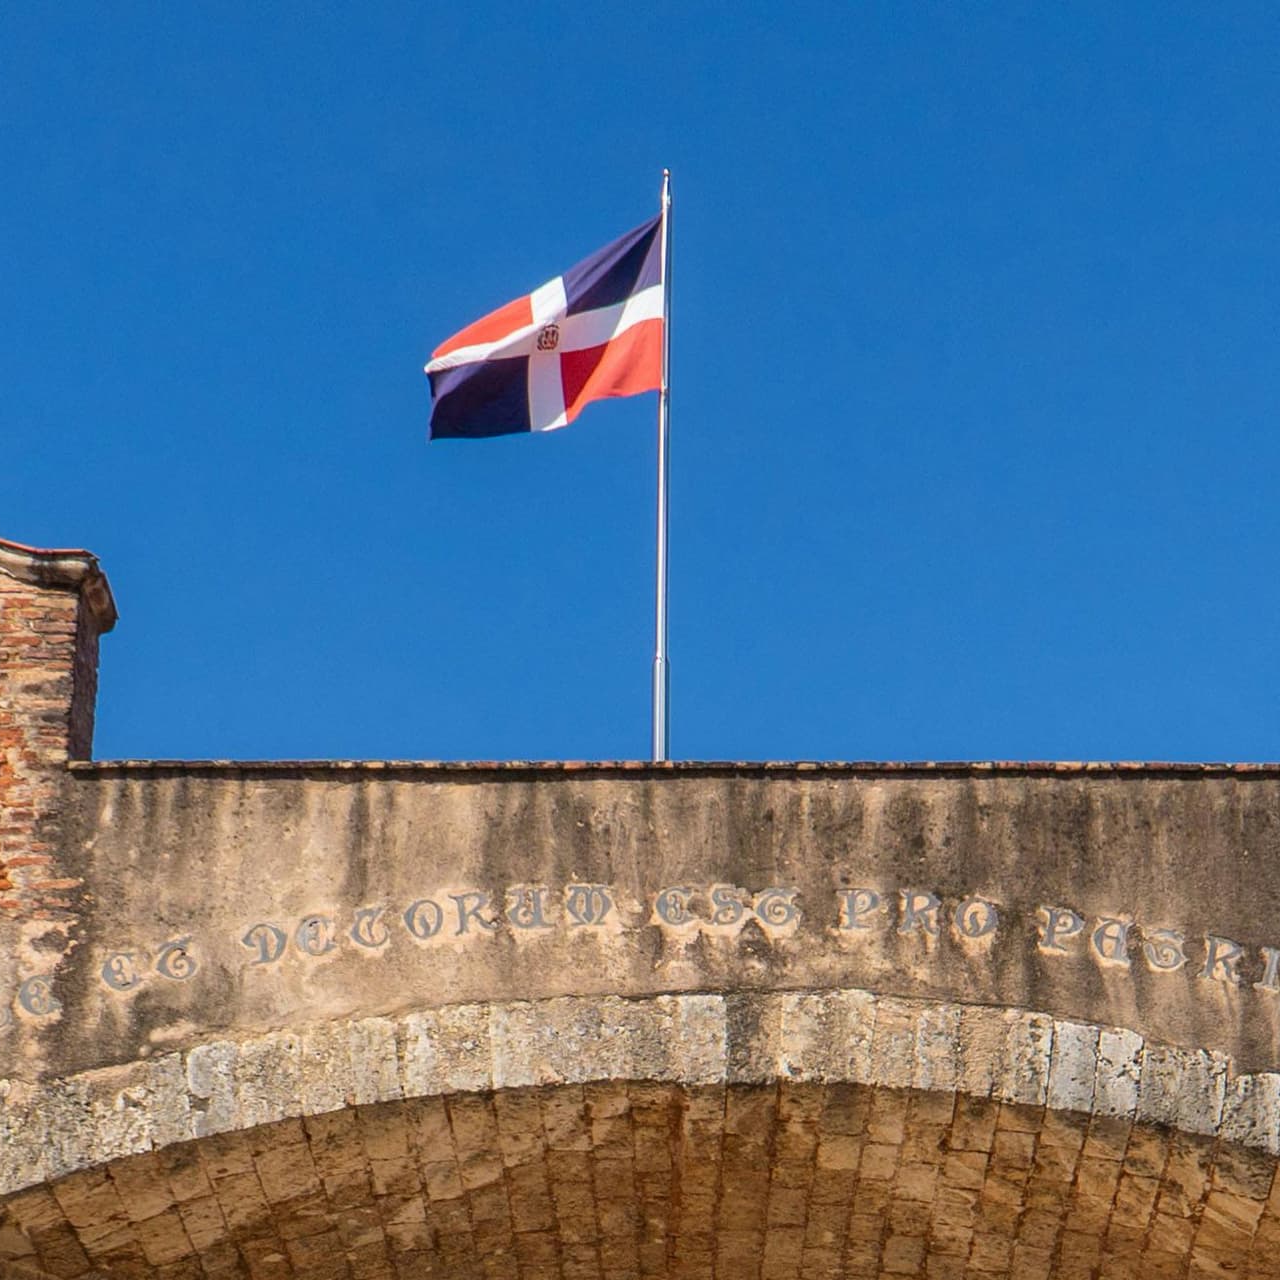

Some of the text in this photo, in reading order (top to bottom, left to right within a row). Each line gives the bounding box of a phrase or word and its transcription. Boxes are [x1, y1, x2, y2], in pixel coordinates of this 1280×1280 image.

[102, 935, 198, 991] ET
[242, 884, 615, 965] DECORUM
[654, 885, 801, 930] EST
[838, 887, 999, 938] PRO
